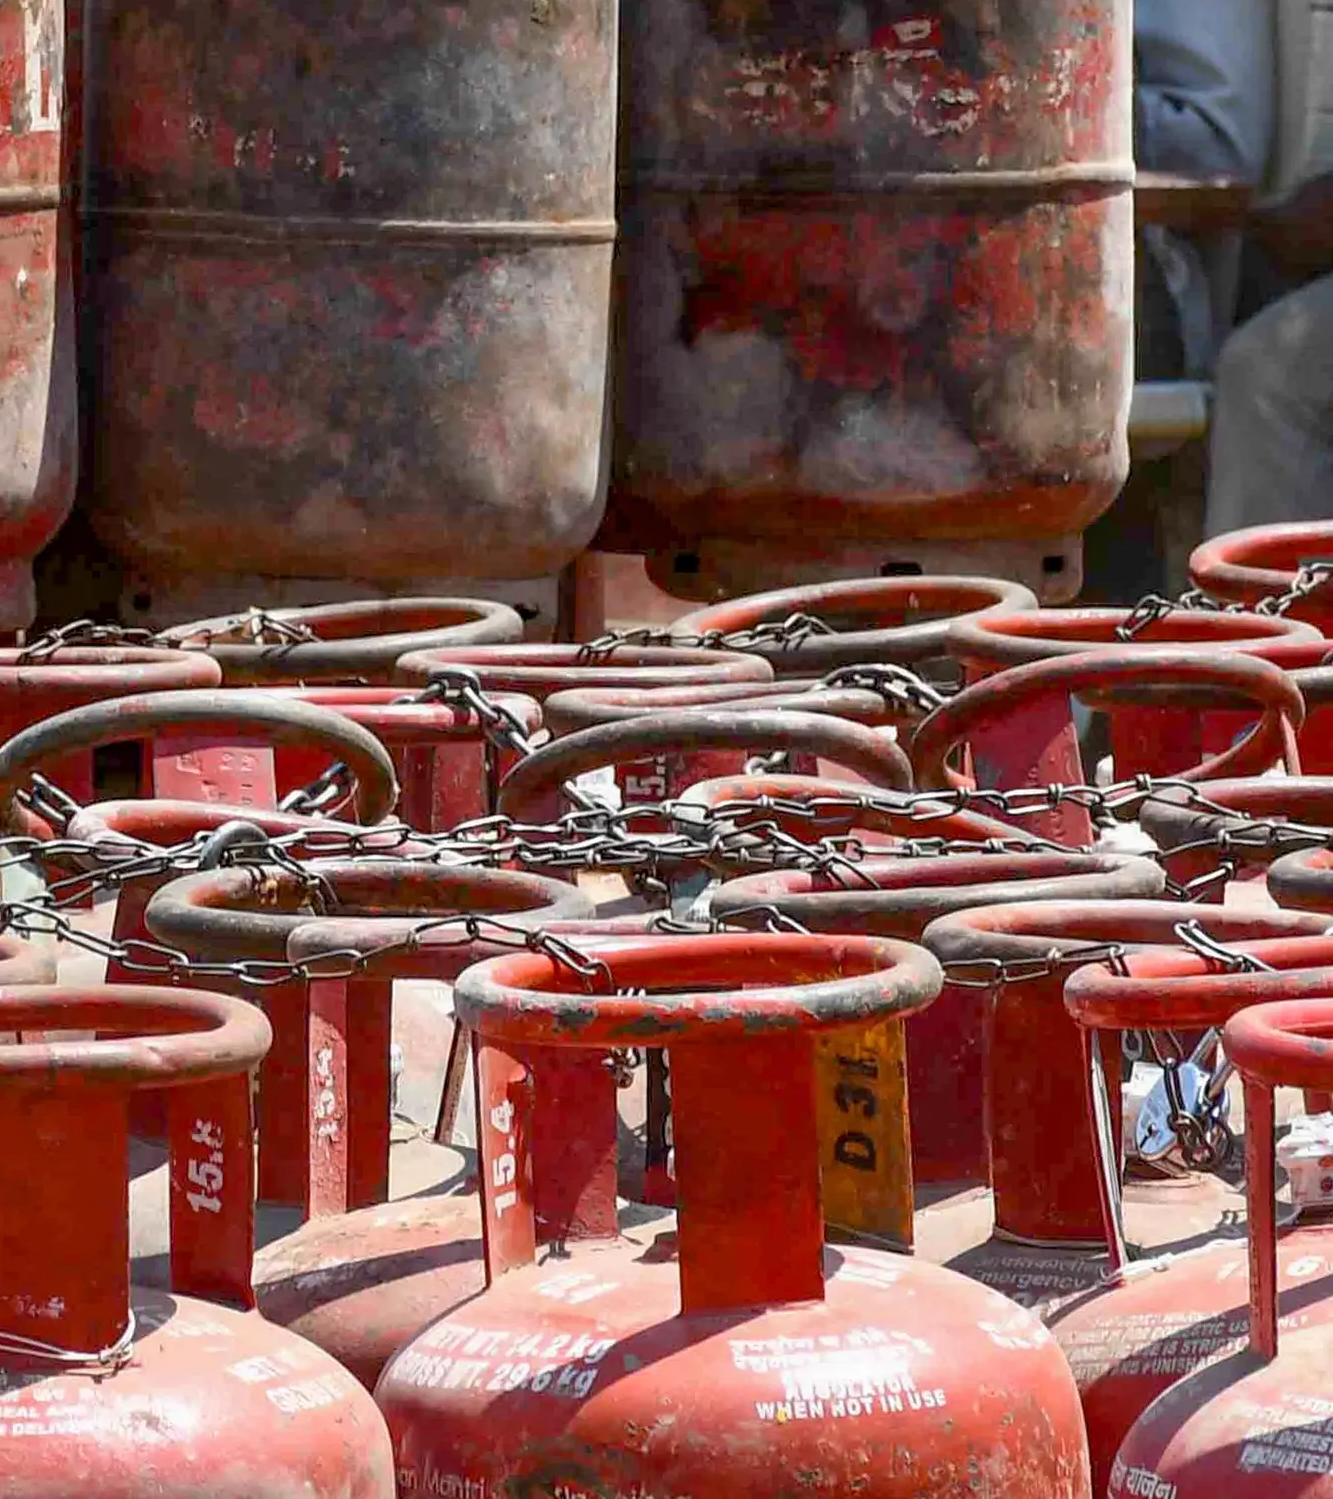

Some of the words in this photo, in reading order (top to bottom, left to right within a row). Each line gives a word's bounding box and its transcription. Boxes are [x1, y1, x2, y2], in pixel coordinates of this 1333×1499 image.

[570, 1333, 618, 1364] kg
[485, 1362, 555, 1392] 29.6
[553, 1366, 599, 1399] kg
[755, 1400, 824, 1422] WHEN
[835, 1400, 874, 1419] NOT
[881, 1398, 904, 1415] IN
[909, 1389, 946, 1411] USE
